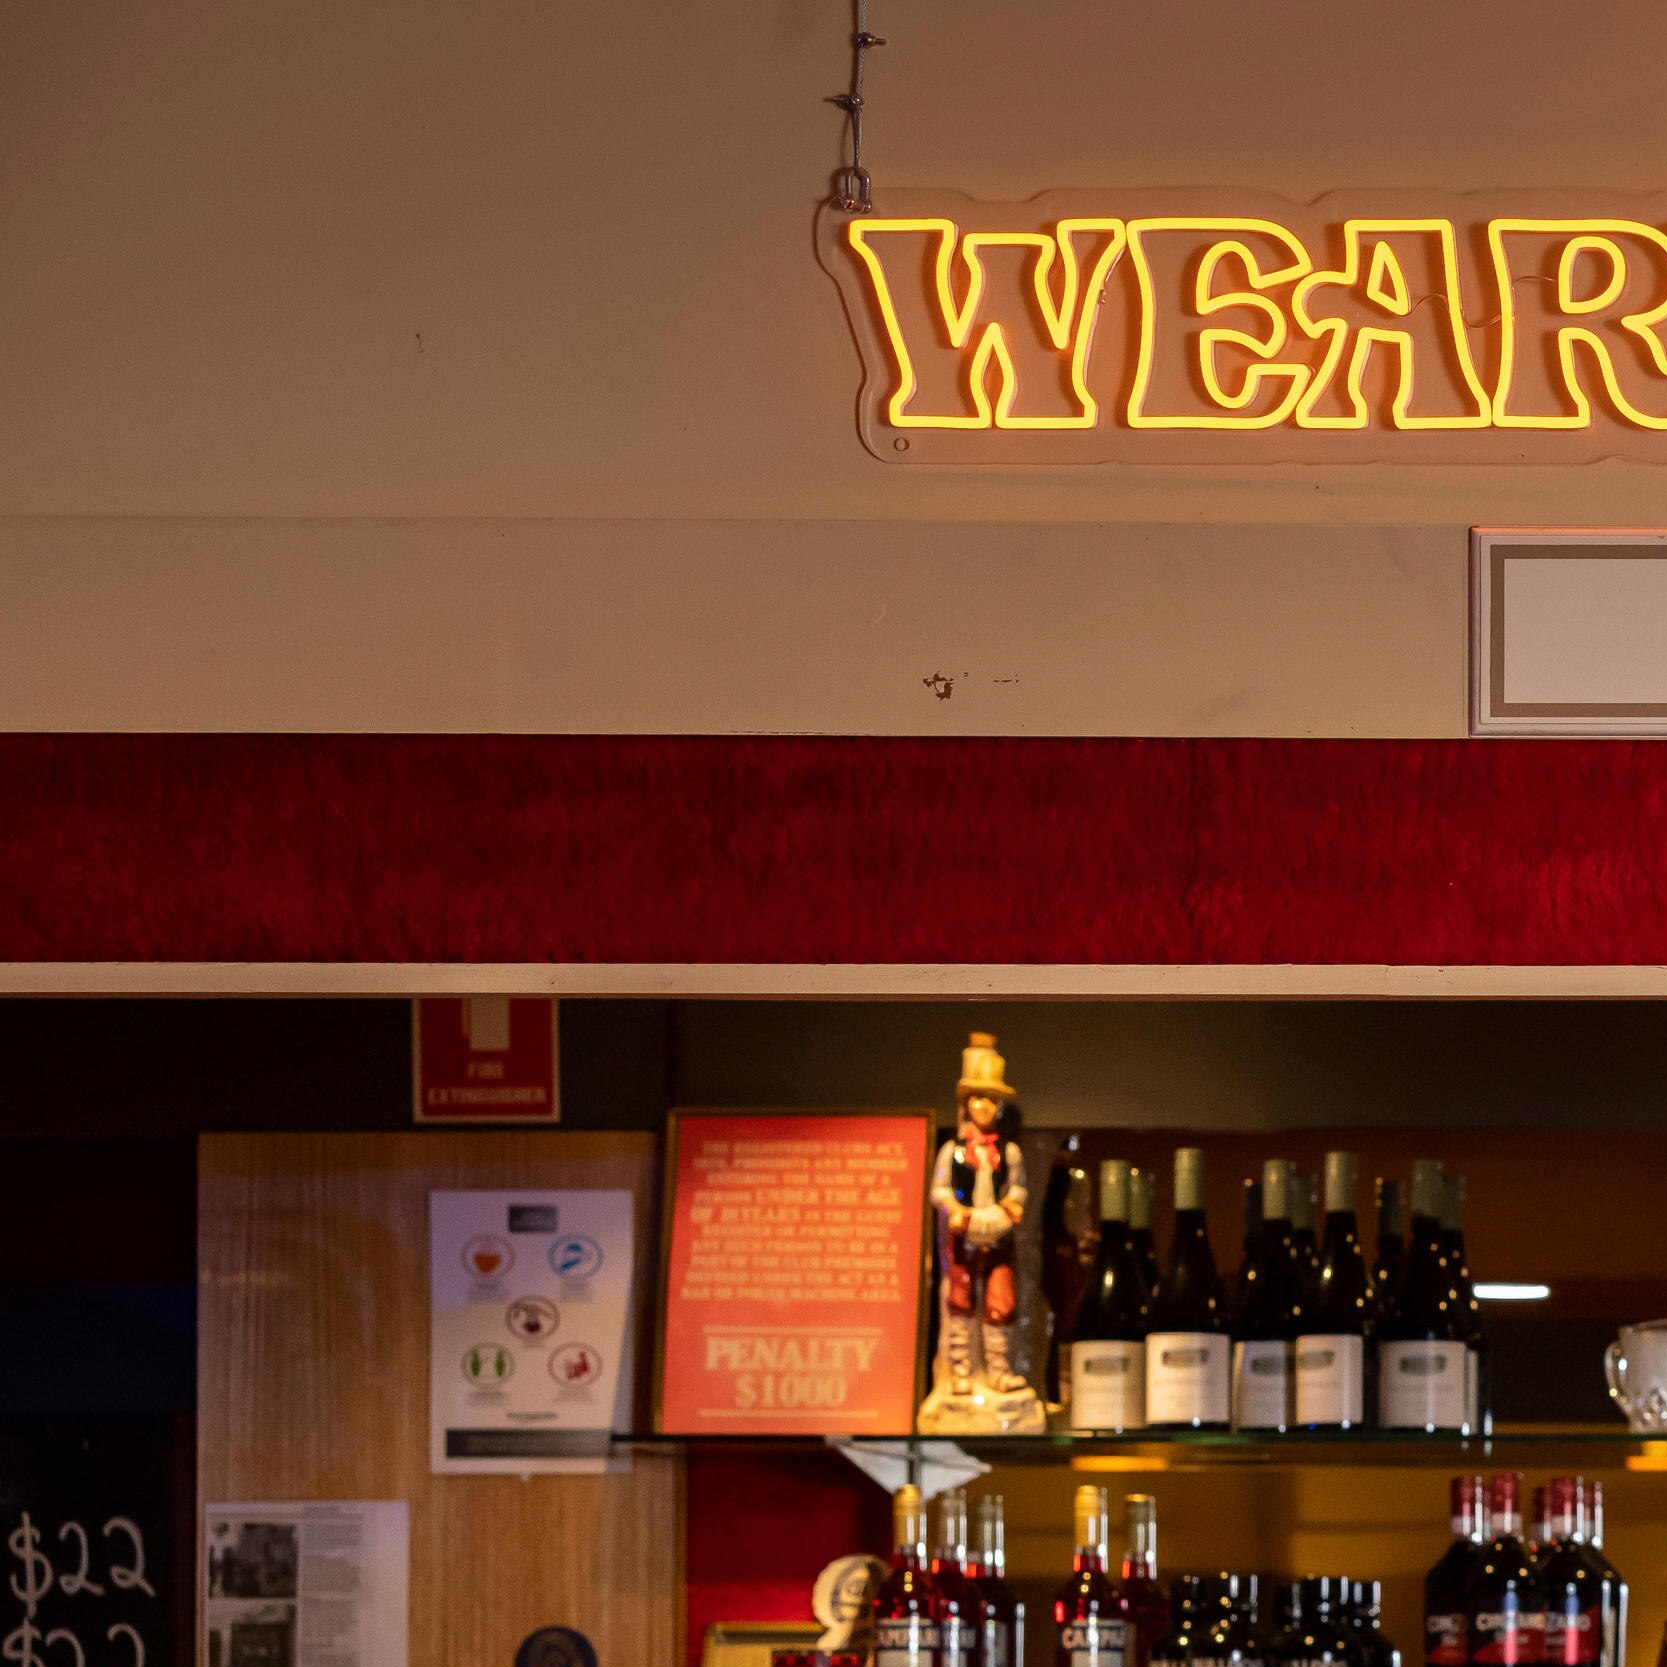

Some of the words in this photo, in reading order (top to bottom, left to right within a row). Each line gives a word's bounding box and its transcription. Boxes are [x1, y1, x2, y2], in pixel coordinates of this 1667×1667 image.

[428, 1087, 547, 1105] EXTINGUISHER
[755, 1189, 819, 1204] UNDER
[825, 1189, 858, 1204] THE
[866, 1189, 901, 1204] AGE
[690, 1208, 714, 1223] OF
[704, 1336, 878, 1371] PENALTY
[735, 1373, 848, 1409] $1000
[9, 1511, 155, 1618] $22
